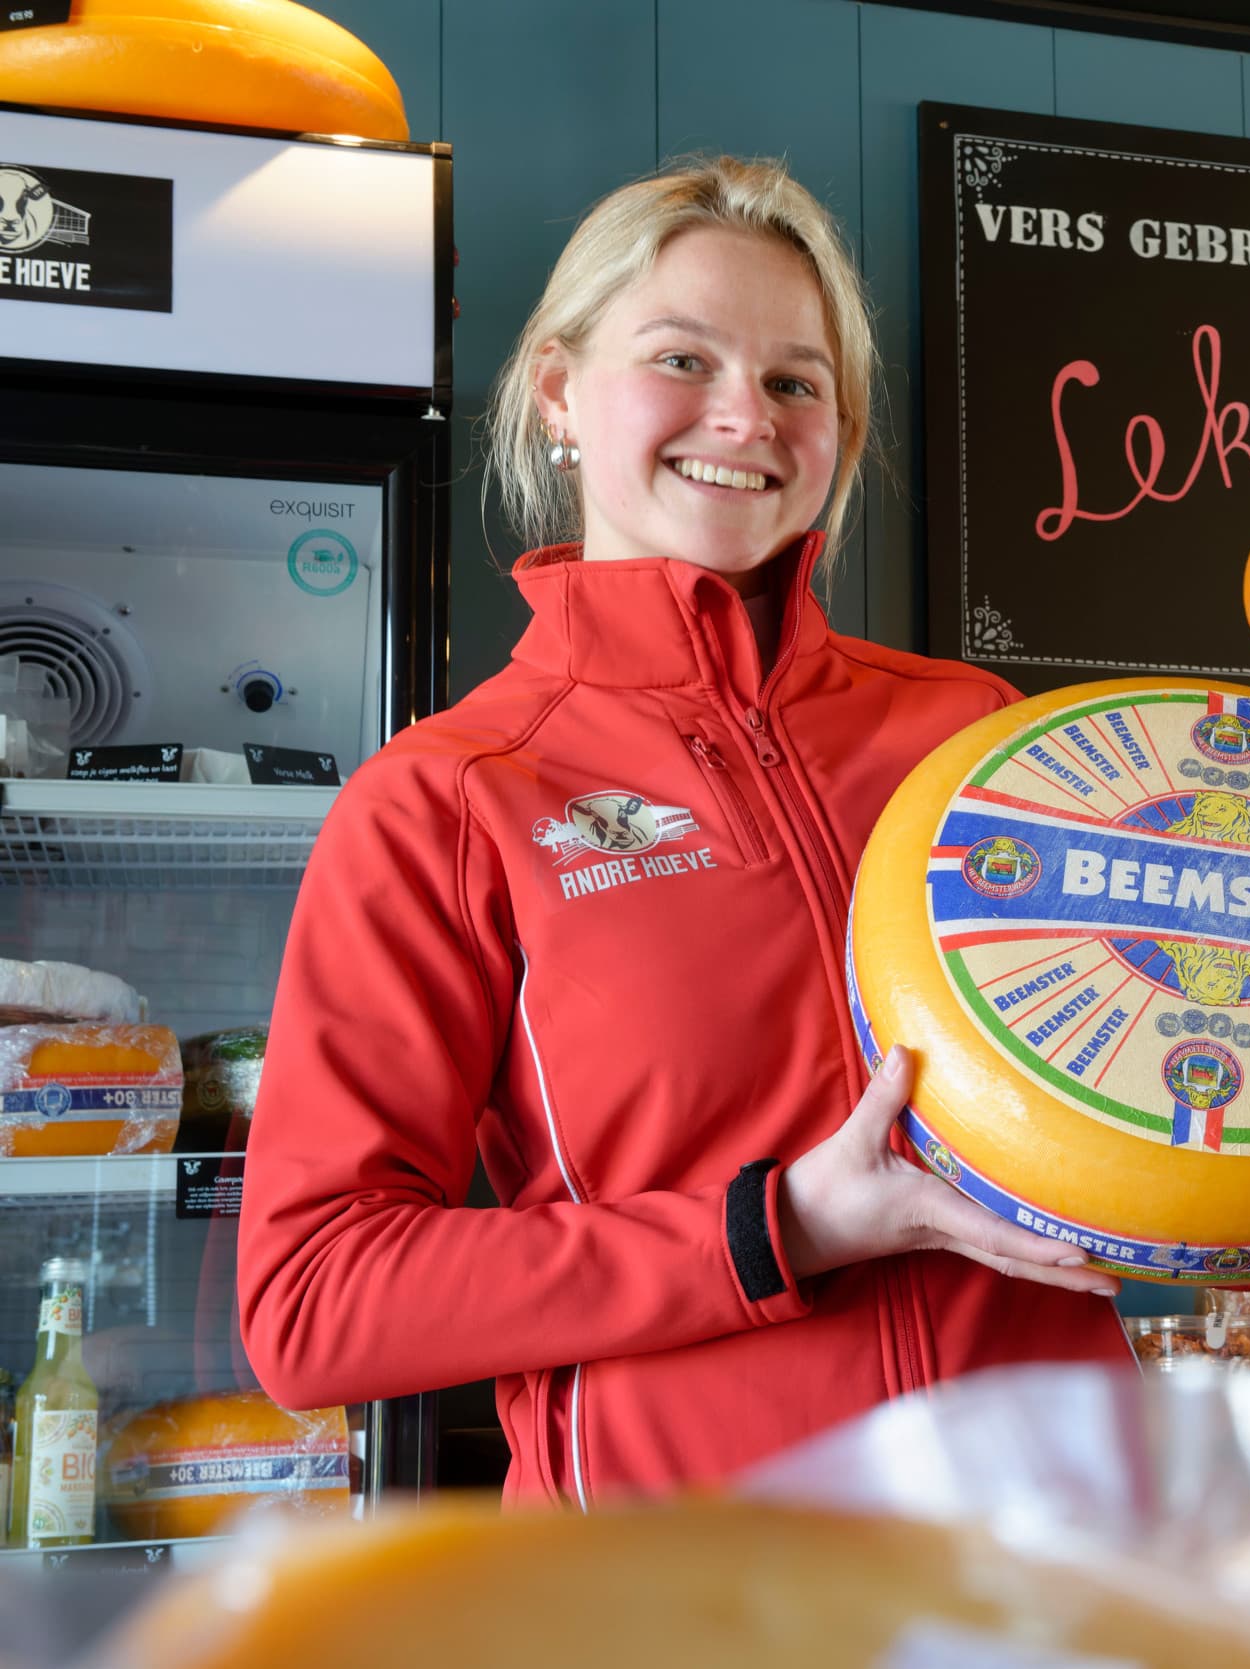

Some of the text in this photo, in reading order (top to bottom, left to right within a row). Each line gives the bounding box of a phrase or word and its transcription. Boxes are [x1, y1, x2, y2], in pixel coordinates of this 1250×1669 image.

[974, 202, 1105, 252] VERS
[15, 257, 91, 292] HOEVE
[1063, 724, 1121, 782] BEEMSTER
[1105, 712, 1152, 771] BEEMSTER
[1025, 744, 1098, 797] BEEMSTER
[559, 848, 718, 900] ANDRE HOEVE
[993, 961, 1076, 1012] BEEMSTER
[1025, 985, 1100, 1047] BEEMSTER
[1066, 1005, 1129, 1076] BEEMSTER
[1016, 1207, 1137, 1260] BEEMSTER
